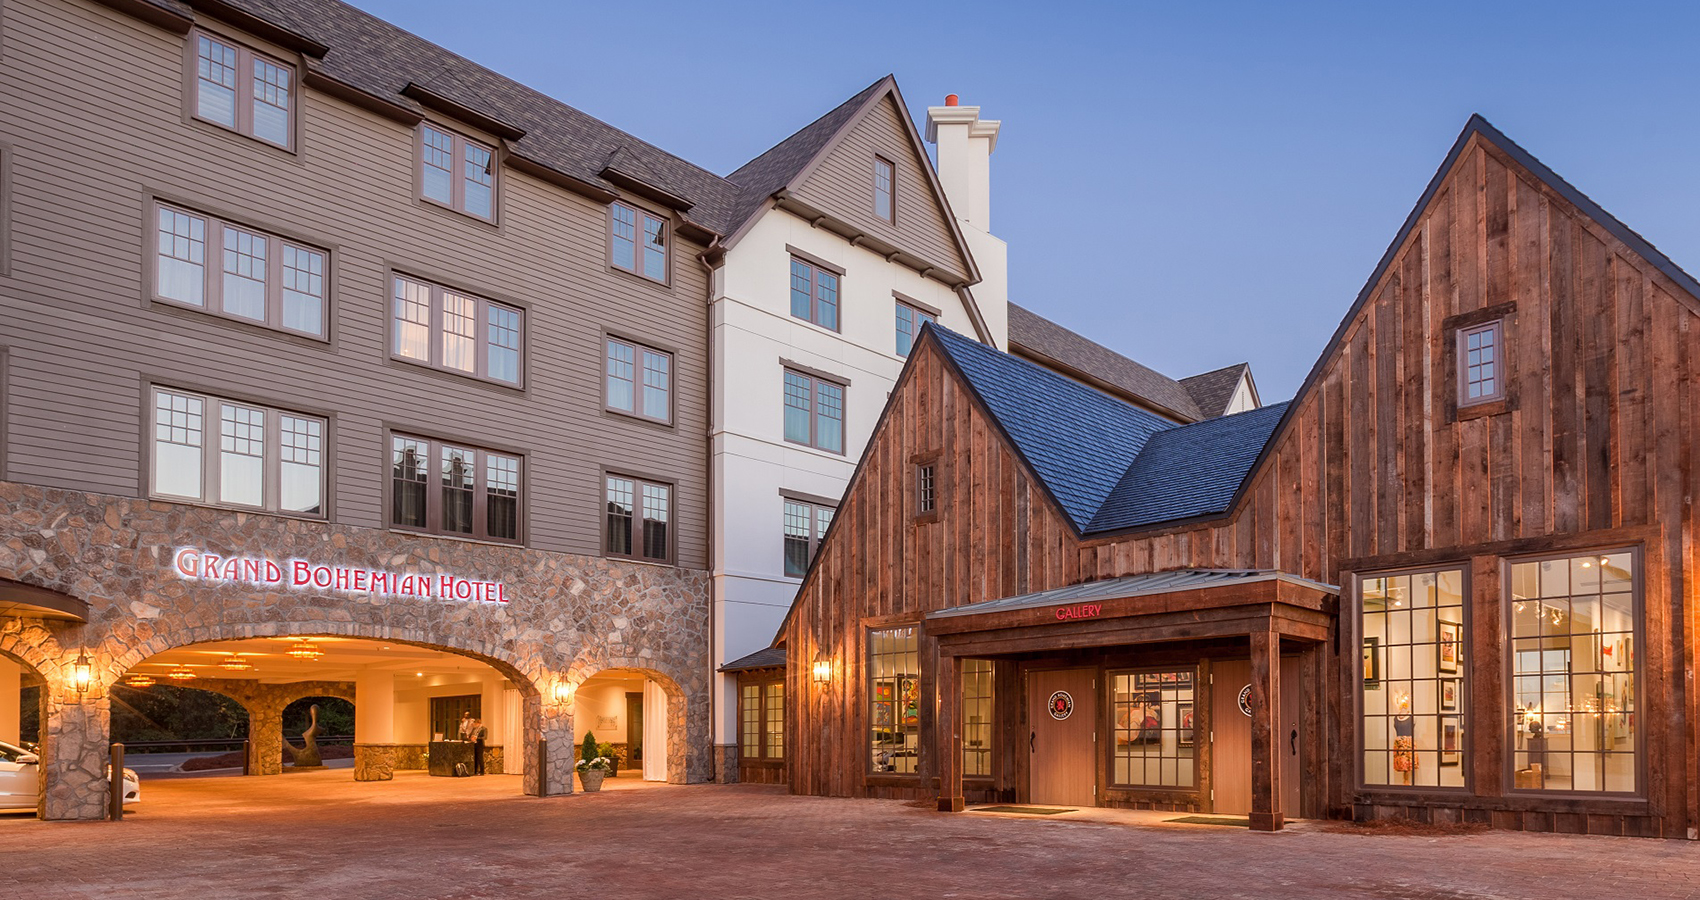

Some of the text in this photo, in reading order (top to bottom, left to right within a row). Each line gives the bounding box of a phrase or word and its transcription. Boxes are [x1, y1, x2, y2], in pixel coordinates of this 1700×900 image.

[176, 549, 509, 603] GRAND BOHEMIAN HOTEL
[1055, 604, 1102, 620] GALLERY
